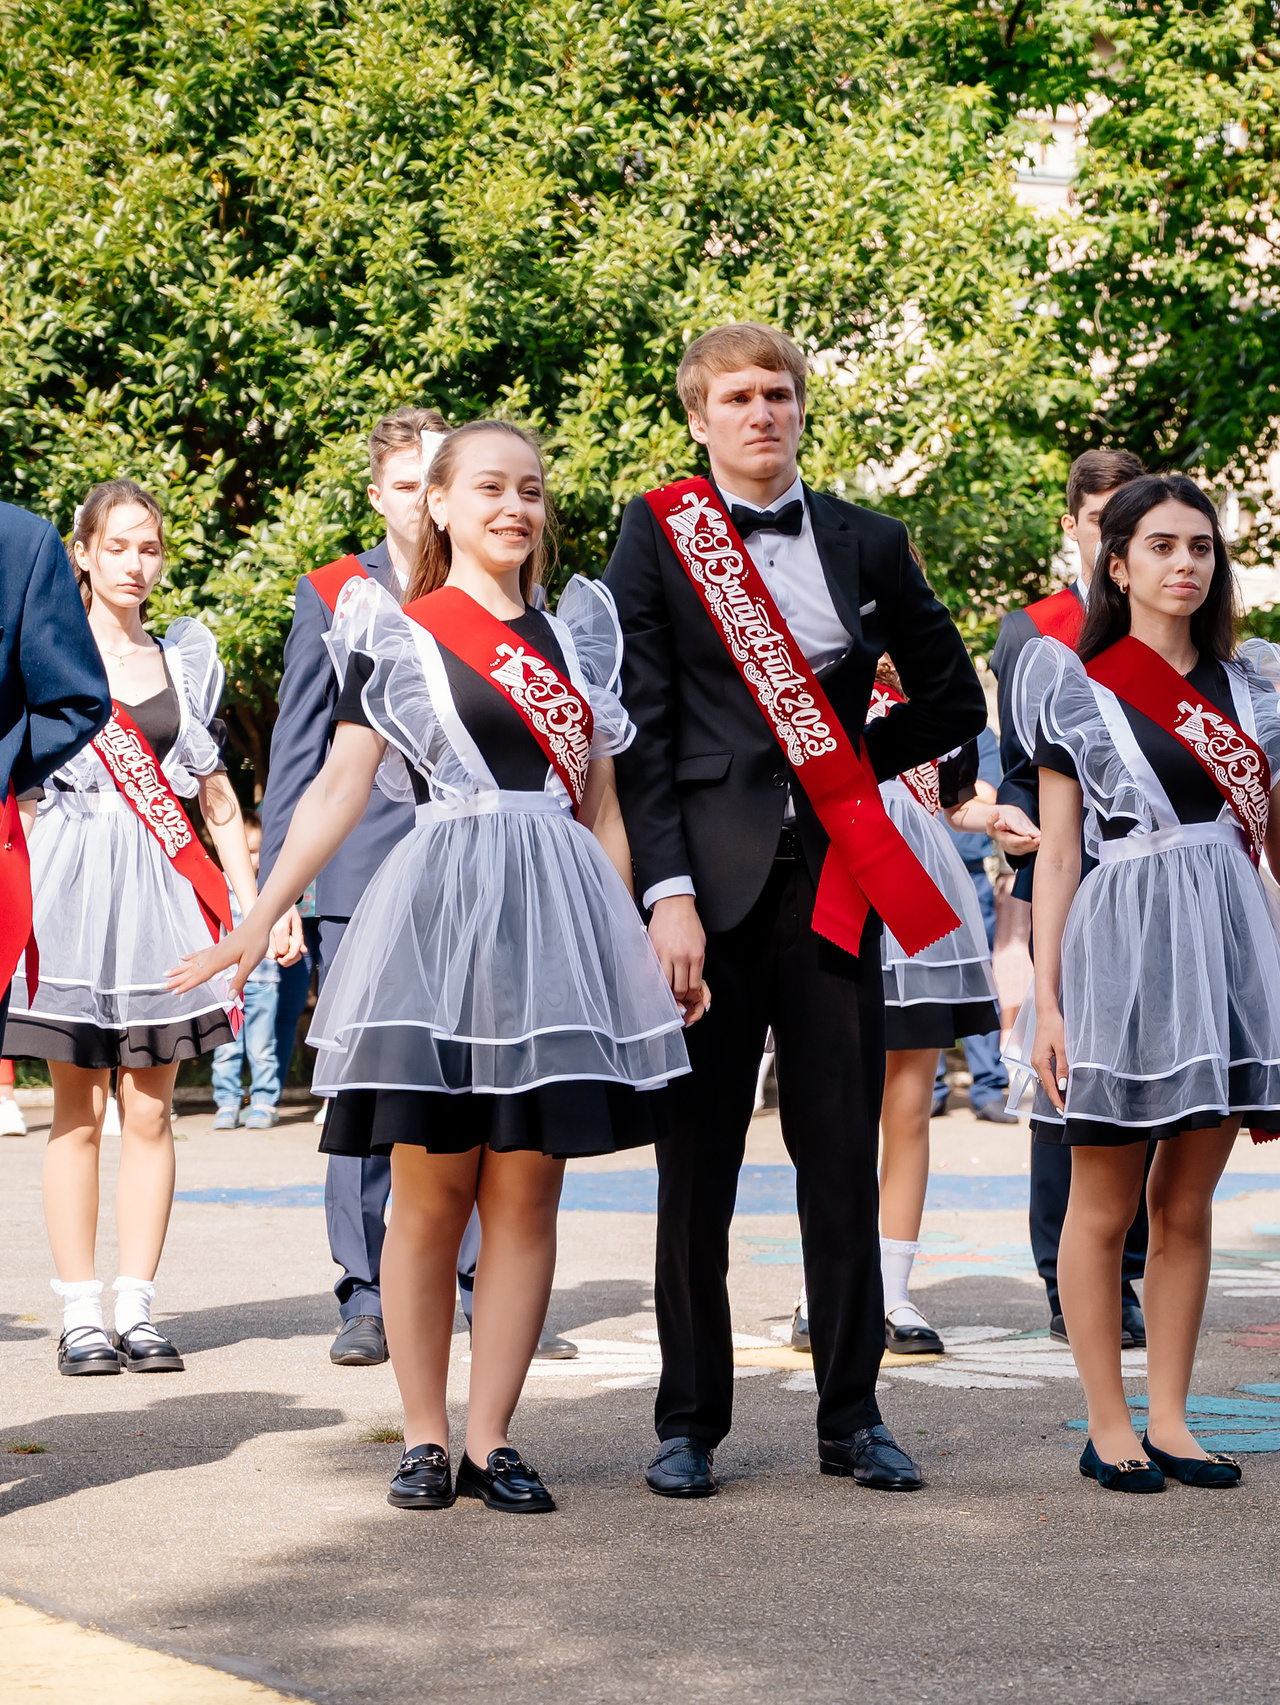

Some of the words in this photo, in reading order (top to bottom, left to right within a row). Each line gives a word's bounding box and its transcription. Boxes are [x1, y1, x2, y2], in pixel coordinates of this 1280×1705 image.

[690, 533, 806, 711] Выпускник
[780, 693, 837, 757] 2023
[102, 716, 168, 818] ыпускник
[151, 798, 192, 849] 2023
